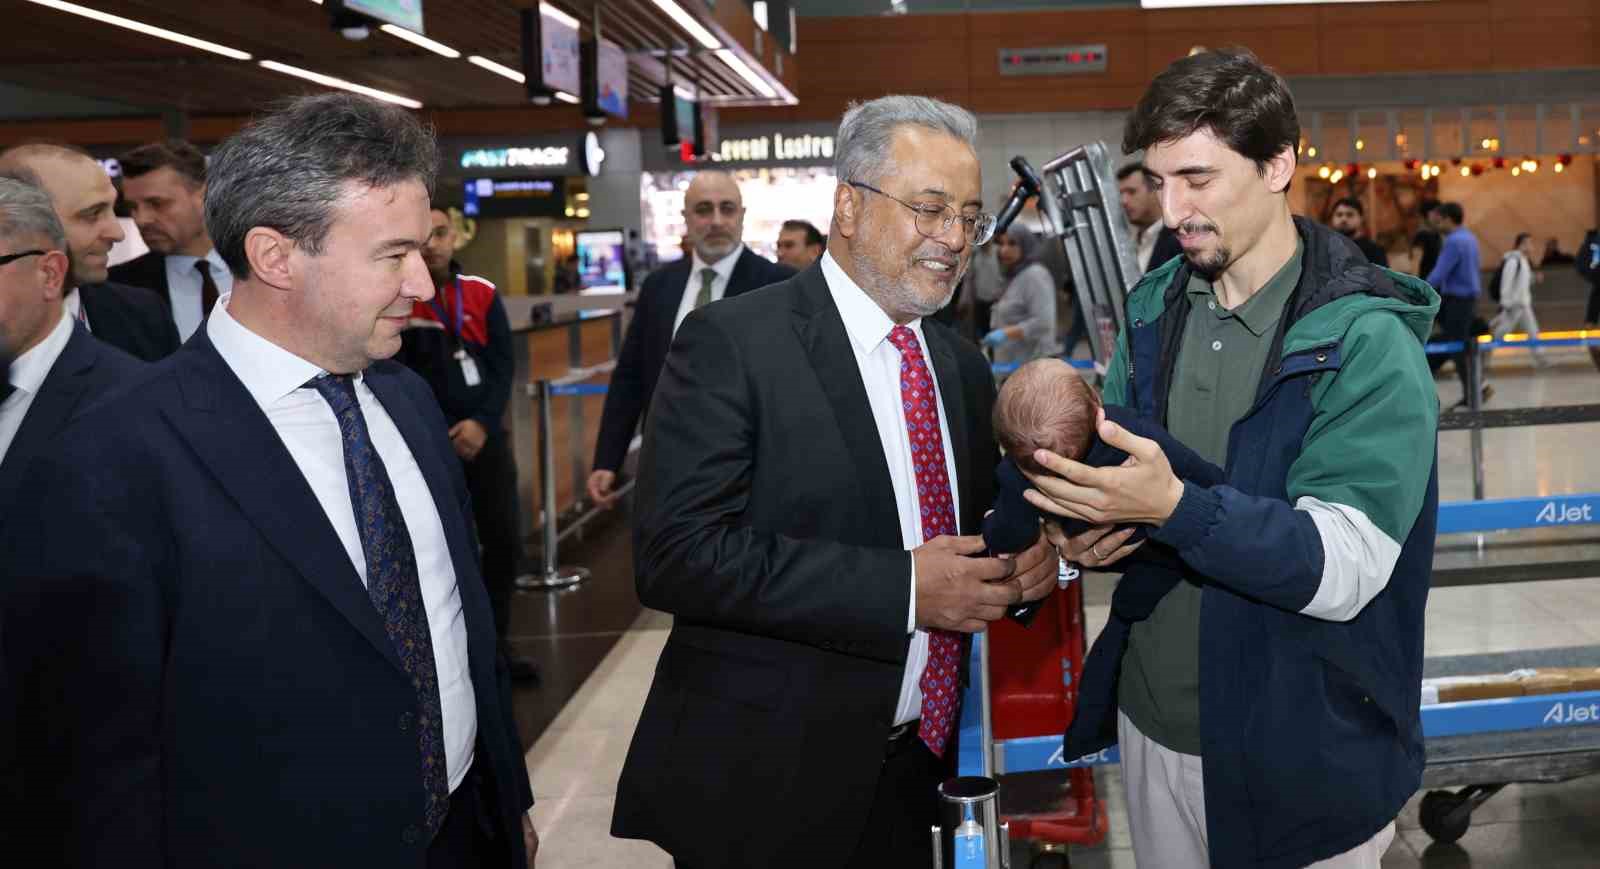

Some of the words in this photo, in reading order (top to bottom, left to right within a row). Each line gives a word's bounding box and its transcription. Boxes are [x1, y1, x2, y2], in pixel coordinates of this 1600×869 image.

[712, 138, 769, 162] event
[1536, 502, 1592, 522] AJet
[1543, 702, 1600, 723] AJet
